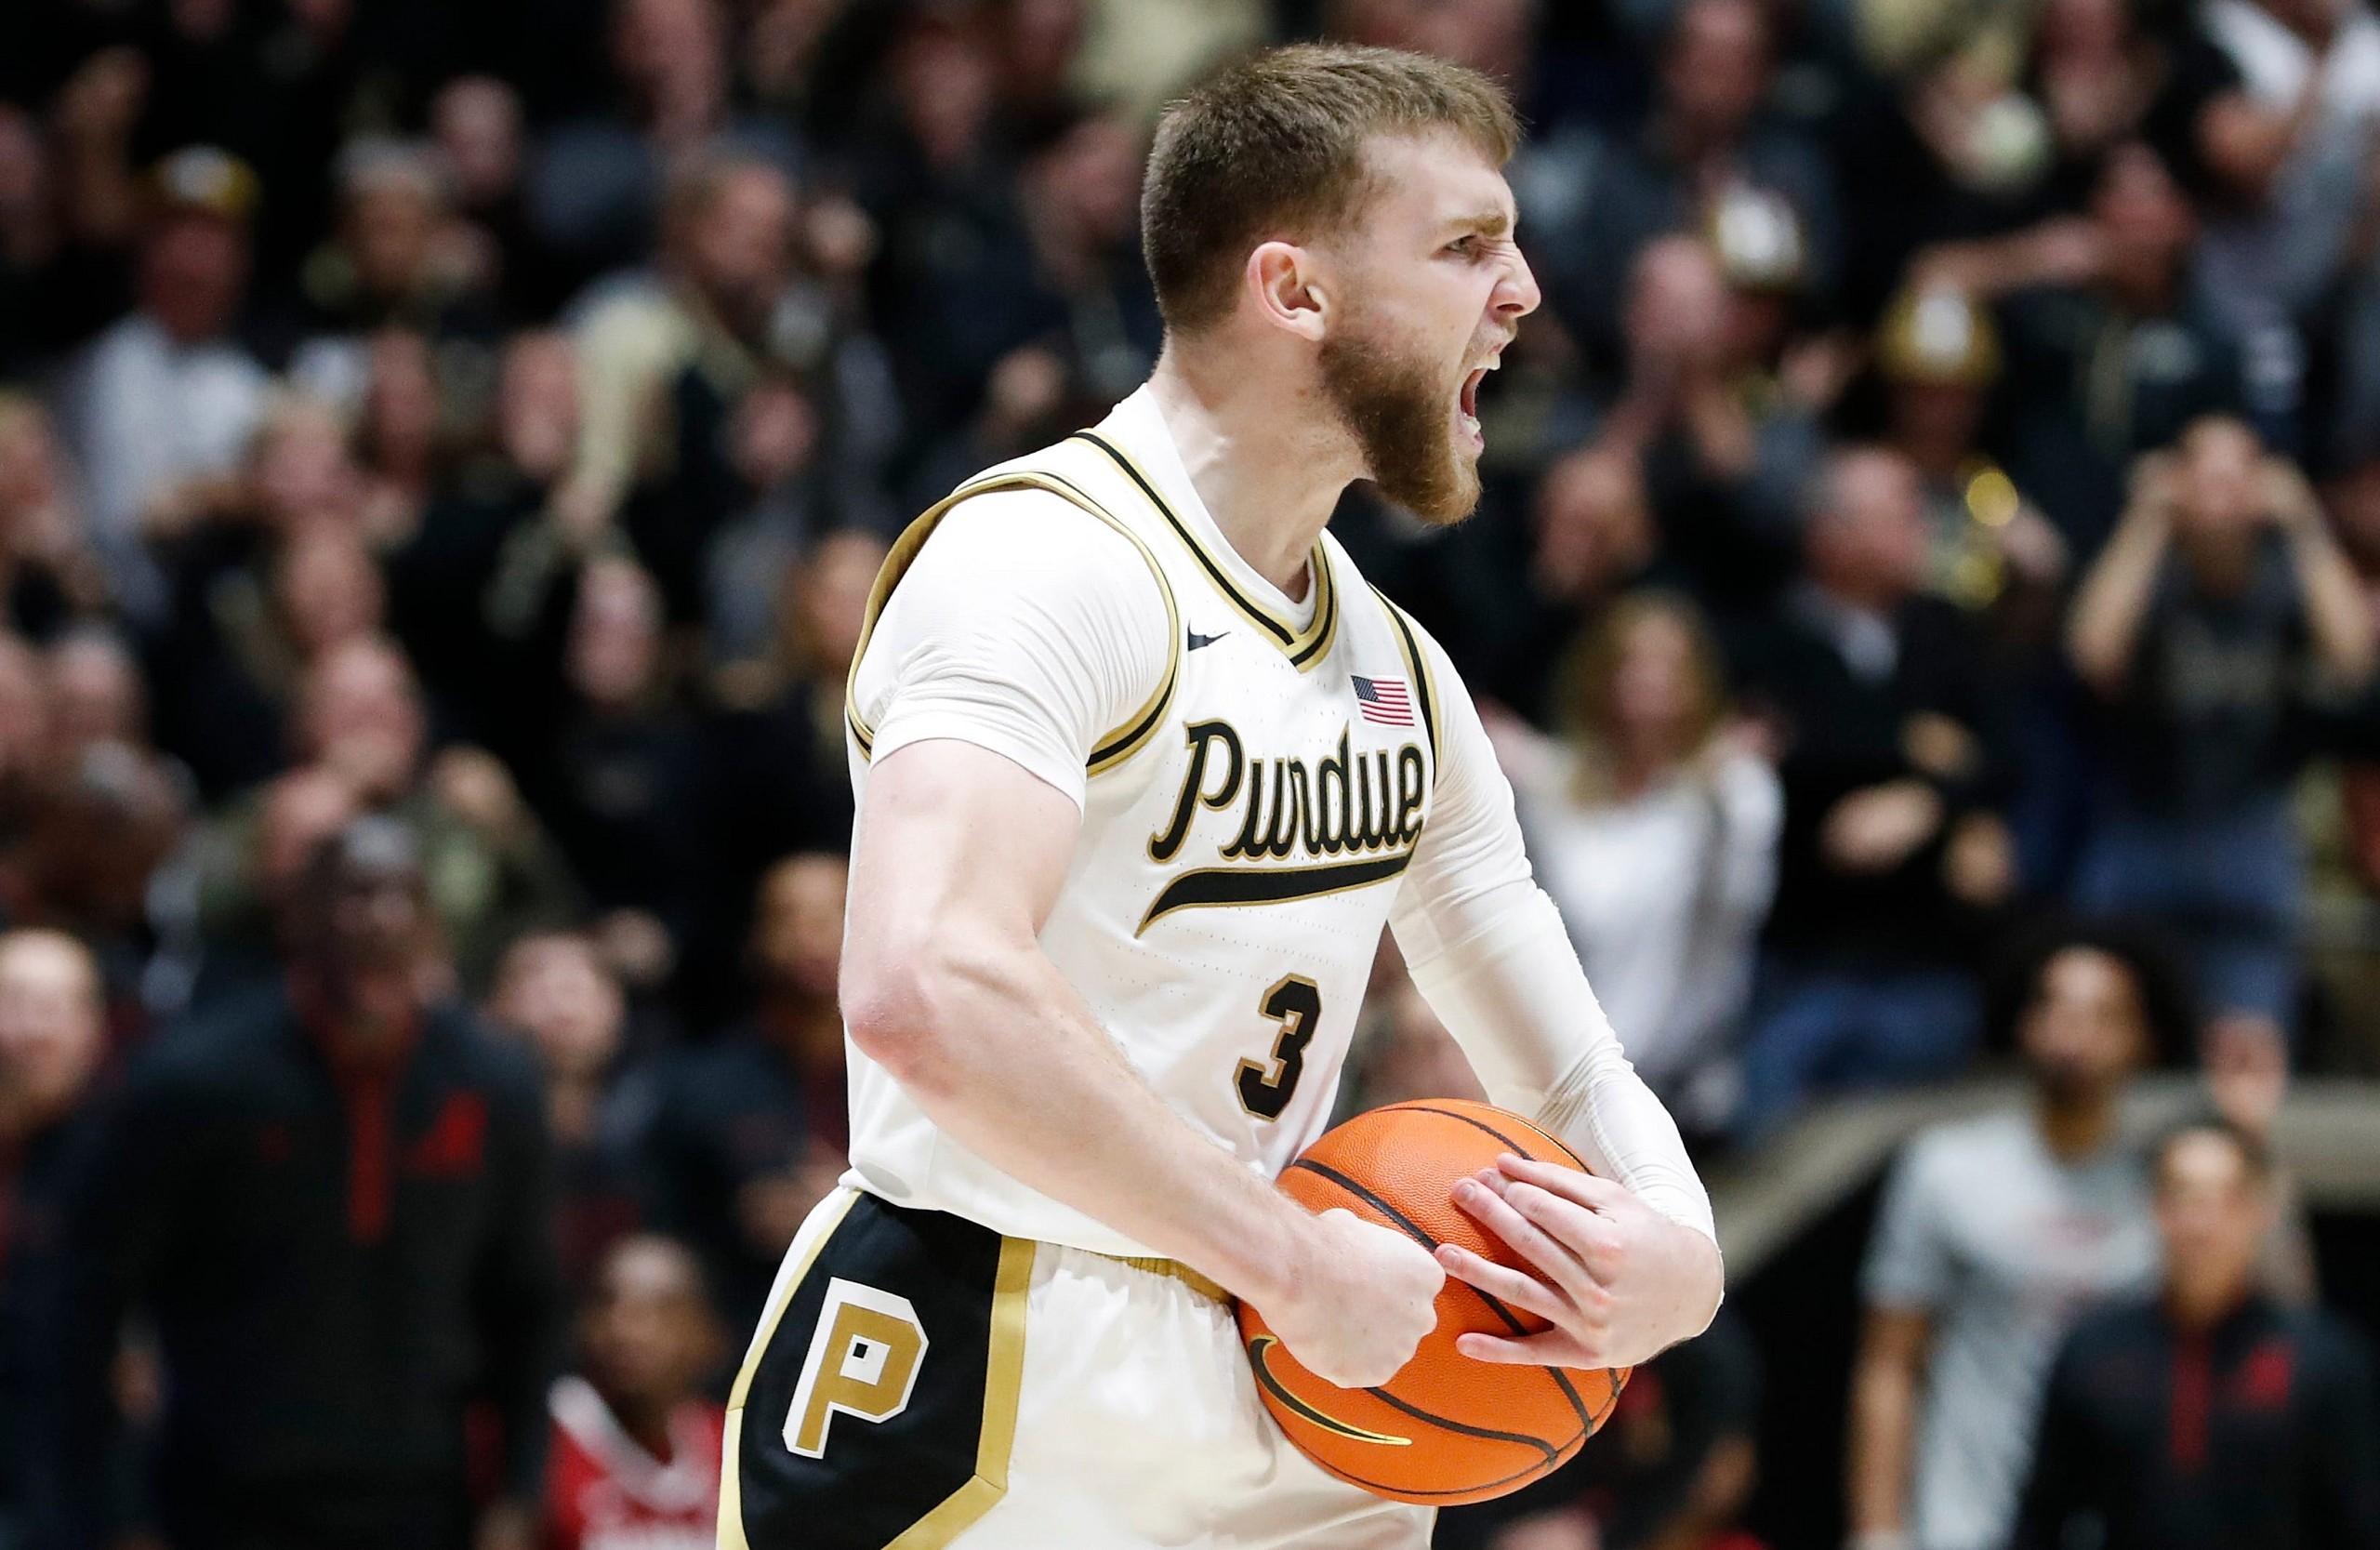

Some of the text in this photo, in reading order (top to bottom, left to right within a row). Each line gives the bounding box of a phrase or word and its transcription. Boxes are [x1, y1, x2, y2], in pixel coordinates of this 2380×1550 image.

[1146, 717, 1426, 864] Purdue
[1233, 973, 1322, 1123] 3
[782, 1276, 930, 1460] P
